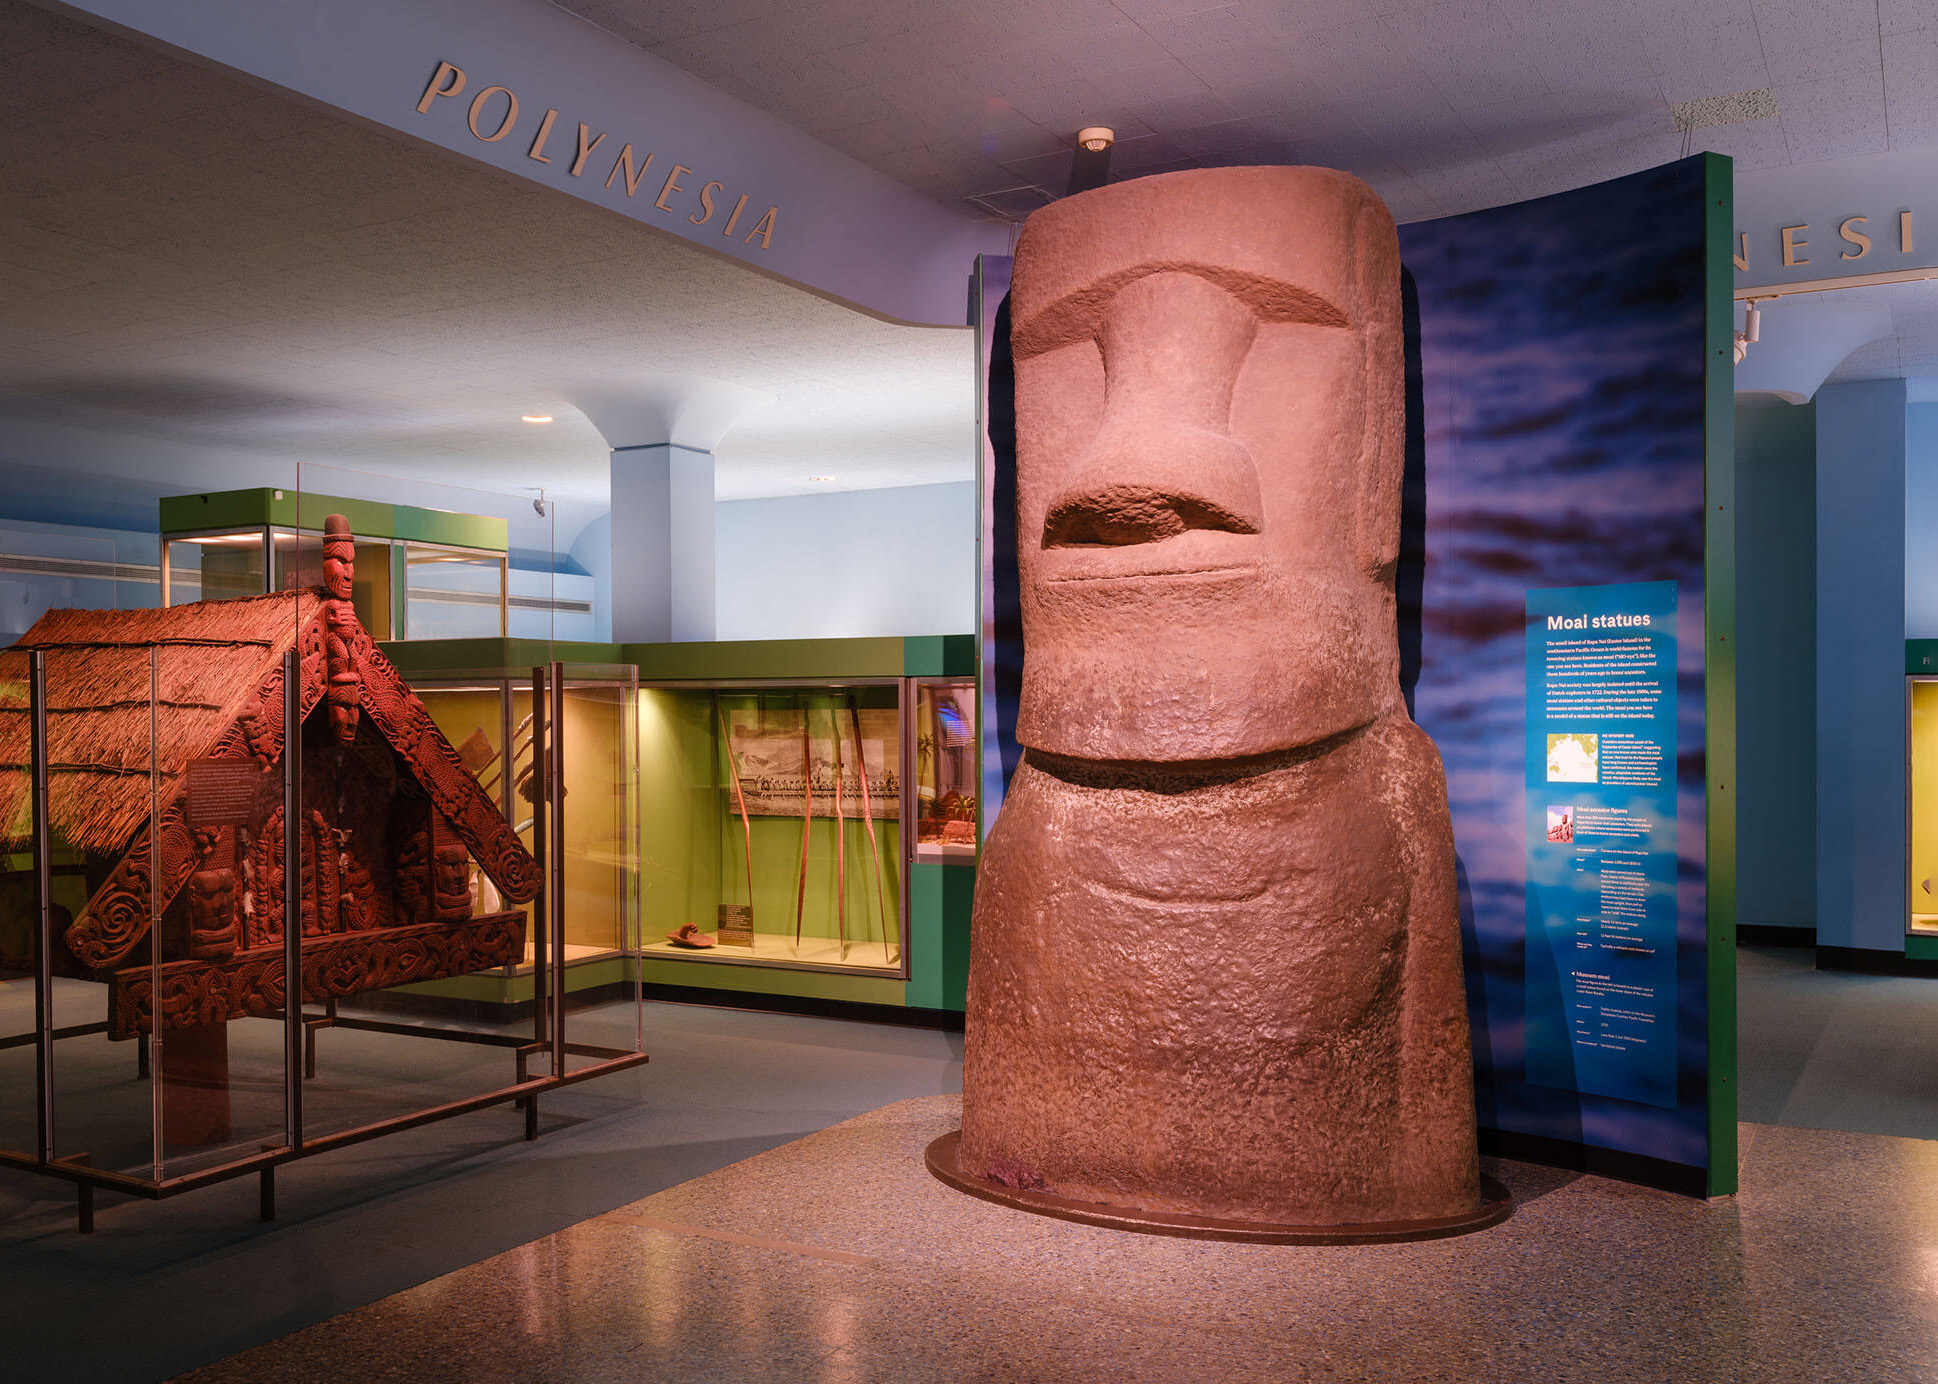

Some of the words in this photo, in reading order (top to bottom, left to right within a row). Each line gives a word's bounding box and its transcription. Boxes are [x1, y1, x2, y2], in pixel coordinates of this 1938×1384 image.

[415, 61, 778, 249] POLYNESIA
[1547, 613, 1588, 630] Moai
[1592, 613, 1651, 628] statues
